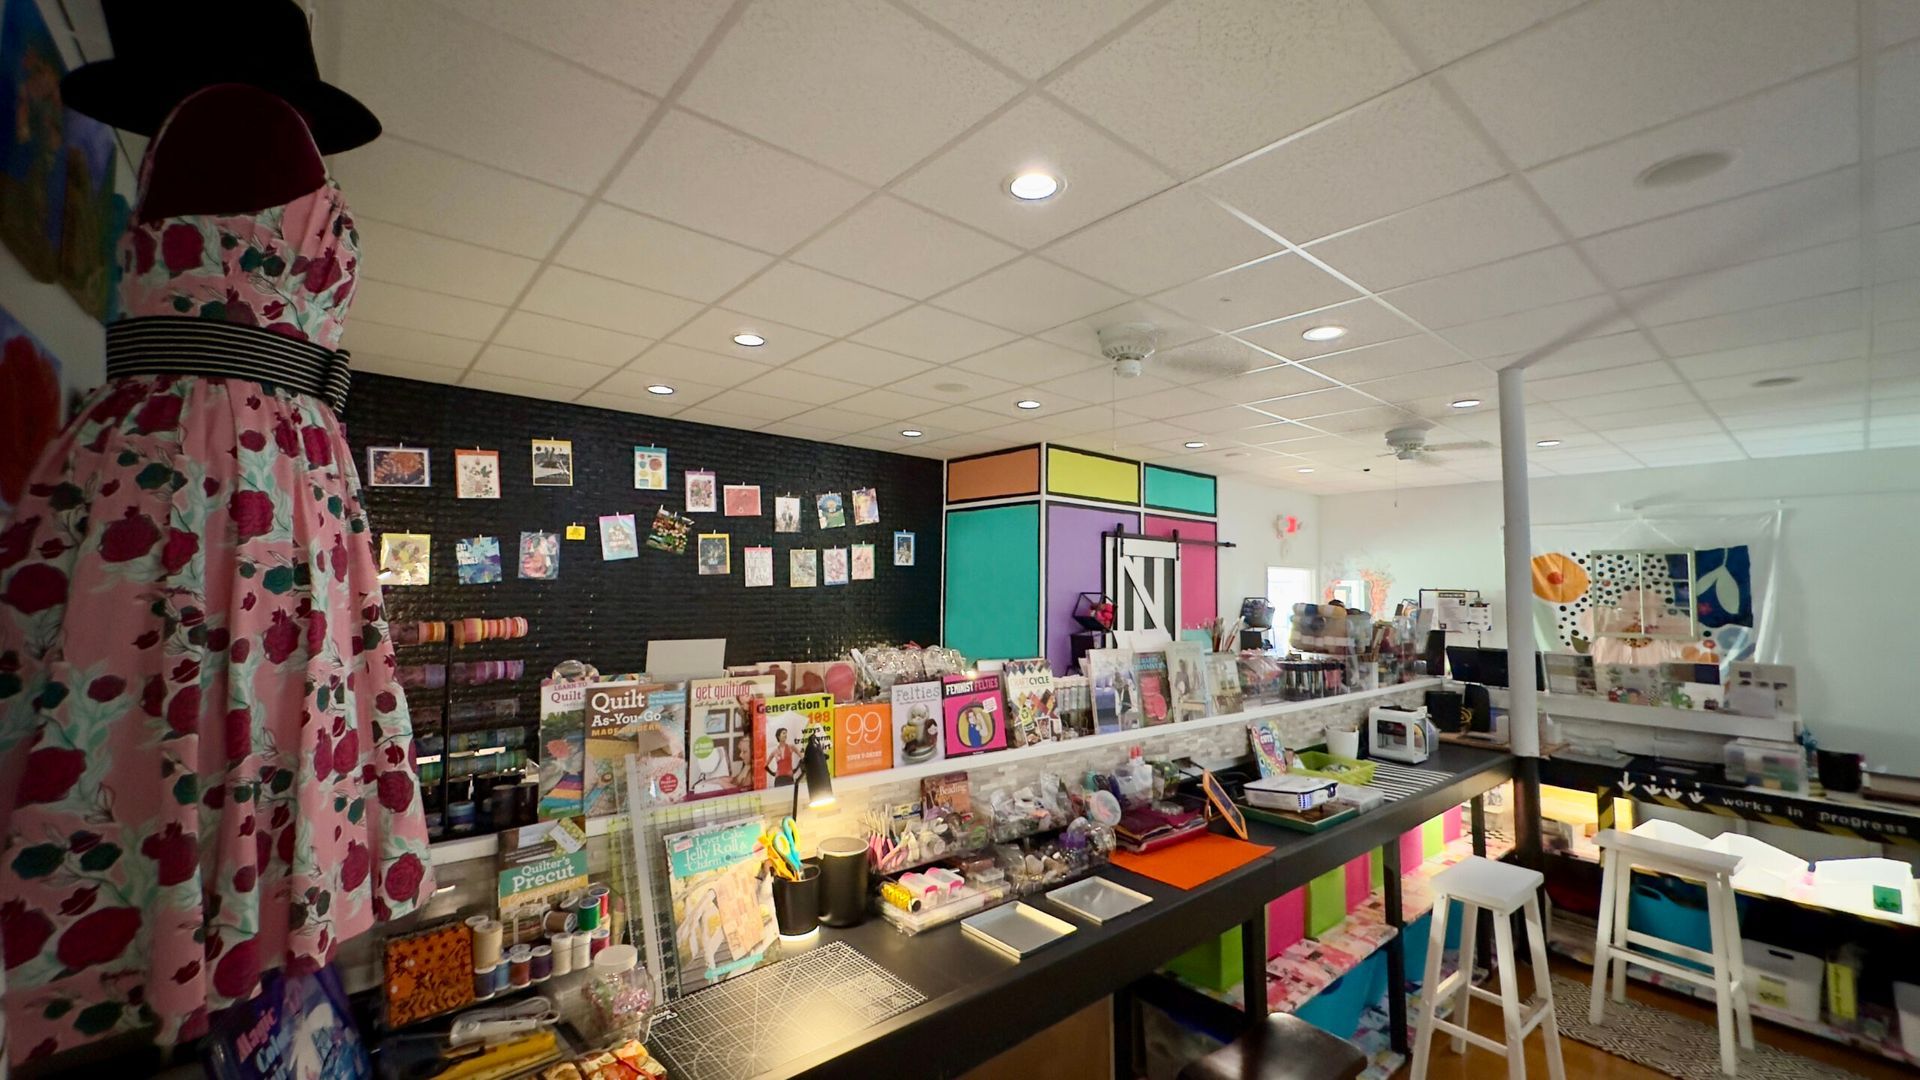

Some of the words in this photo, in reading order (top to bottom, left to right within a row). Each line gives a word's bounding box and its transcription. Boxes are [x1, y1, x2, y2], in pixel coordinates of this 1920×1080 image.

[696, 684, 711, 701] get
[714, 680, 751, 700] quilting
[896, 685, 940, 701] Felties
[946, 681, 974, 695] FEMINIST
[974, 677, 998, 691] FELTIES
[591, 689, 645, 713] Quilt
[756, 699, 820, 714] Generation
[822, 696, 831, 708] T
[591, 710, 661, 728] As-You-Go
[807, 711, 831, 724] 108
[591, 727, 619, 737] MADE
[845, 711, 882, 746] 99
[1722, 797, 1773, 813] works
[1787, 806, 1803, 817] in
[1820, 811, 1908, 834] progress
[685, 847, 711, 865] Jelly
[713, 839, 738, 856] Roll
[521, 857, 571, 876] Quilter's
[512, 865, 575, 893] Precut
